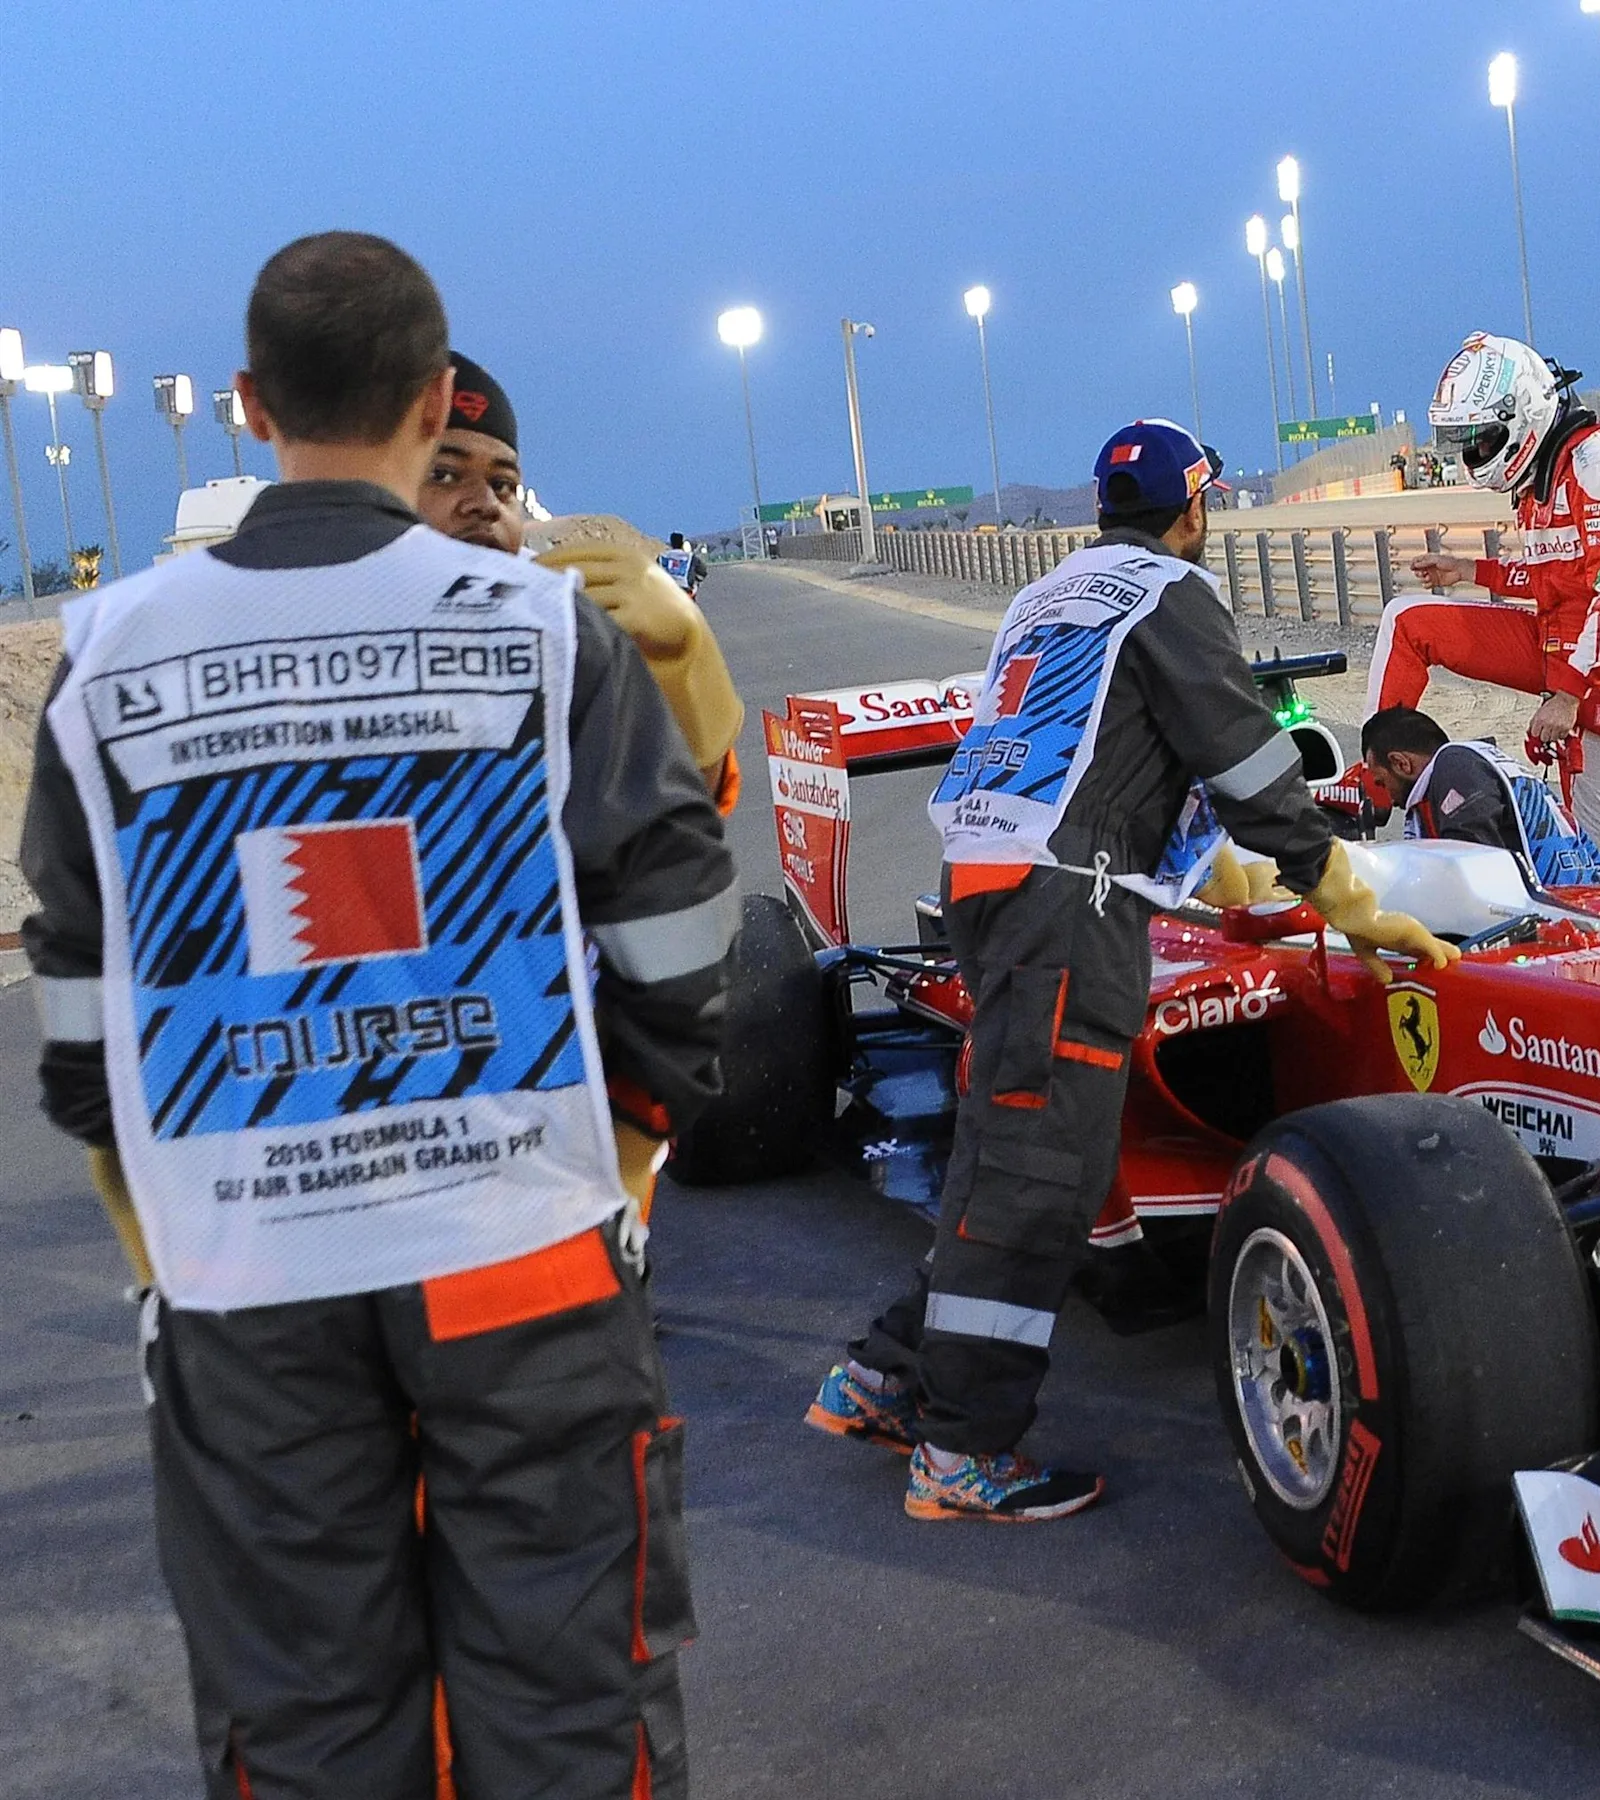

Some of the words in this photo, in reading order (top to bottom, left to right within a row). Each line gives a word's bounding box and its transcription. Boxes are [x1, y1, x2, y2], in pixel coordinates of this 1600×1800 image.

[1288, 432, 1319, 442] ROLEX
[1337, 427, 1368, 437] ROLEX
[1087, 578, 1140, 607] 2016
[202, 643, 408, 701] BHR1097
[427, 642, 532, 678] 2016
[169, 718, 334, 765] INTERVENTION
[343, 709, 461, 744] MARSHAL
[787, 770, 841, 812] Santander
[1154, 985, 1270, 1035] Claro
[224, 992, 499, 1079] COURSE
[264, 1139, 323, 1169] 2016
[329, 1117, 450, 1158] FORMULA
[455, 1114, 469, 1137] 1
[1481, 1095, 1573, 1141] WEICHAI
[298, 1151, 408, 1195] BAHRAIN
[413, 1138, 501, 1173] GRAND
